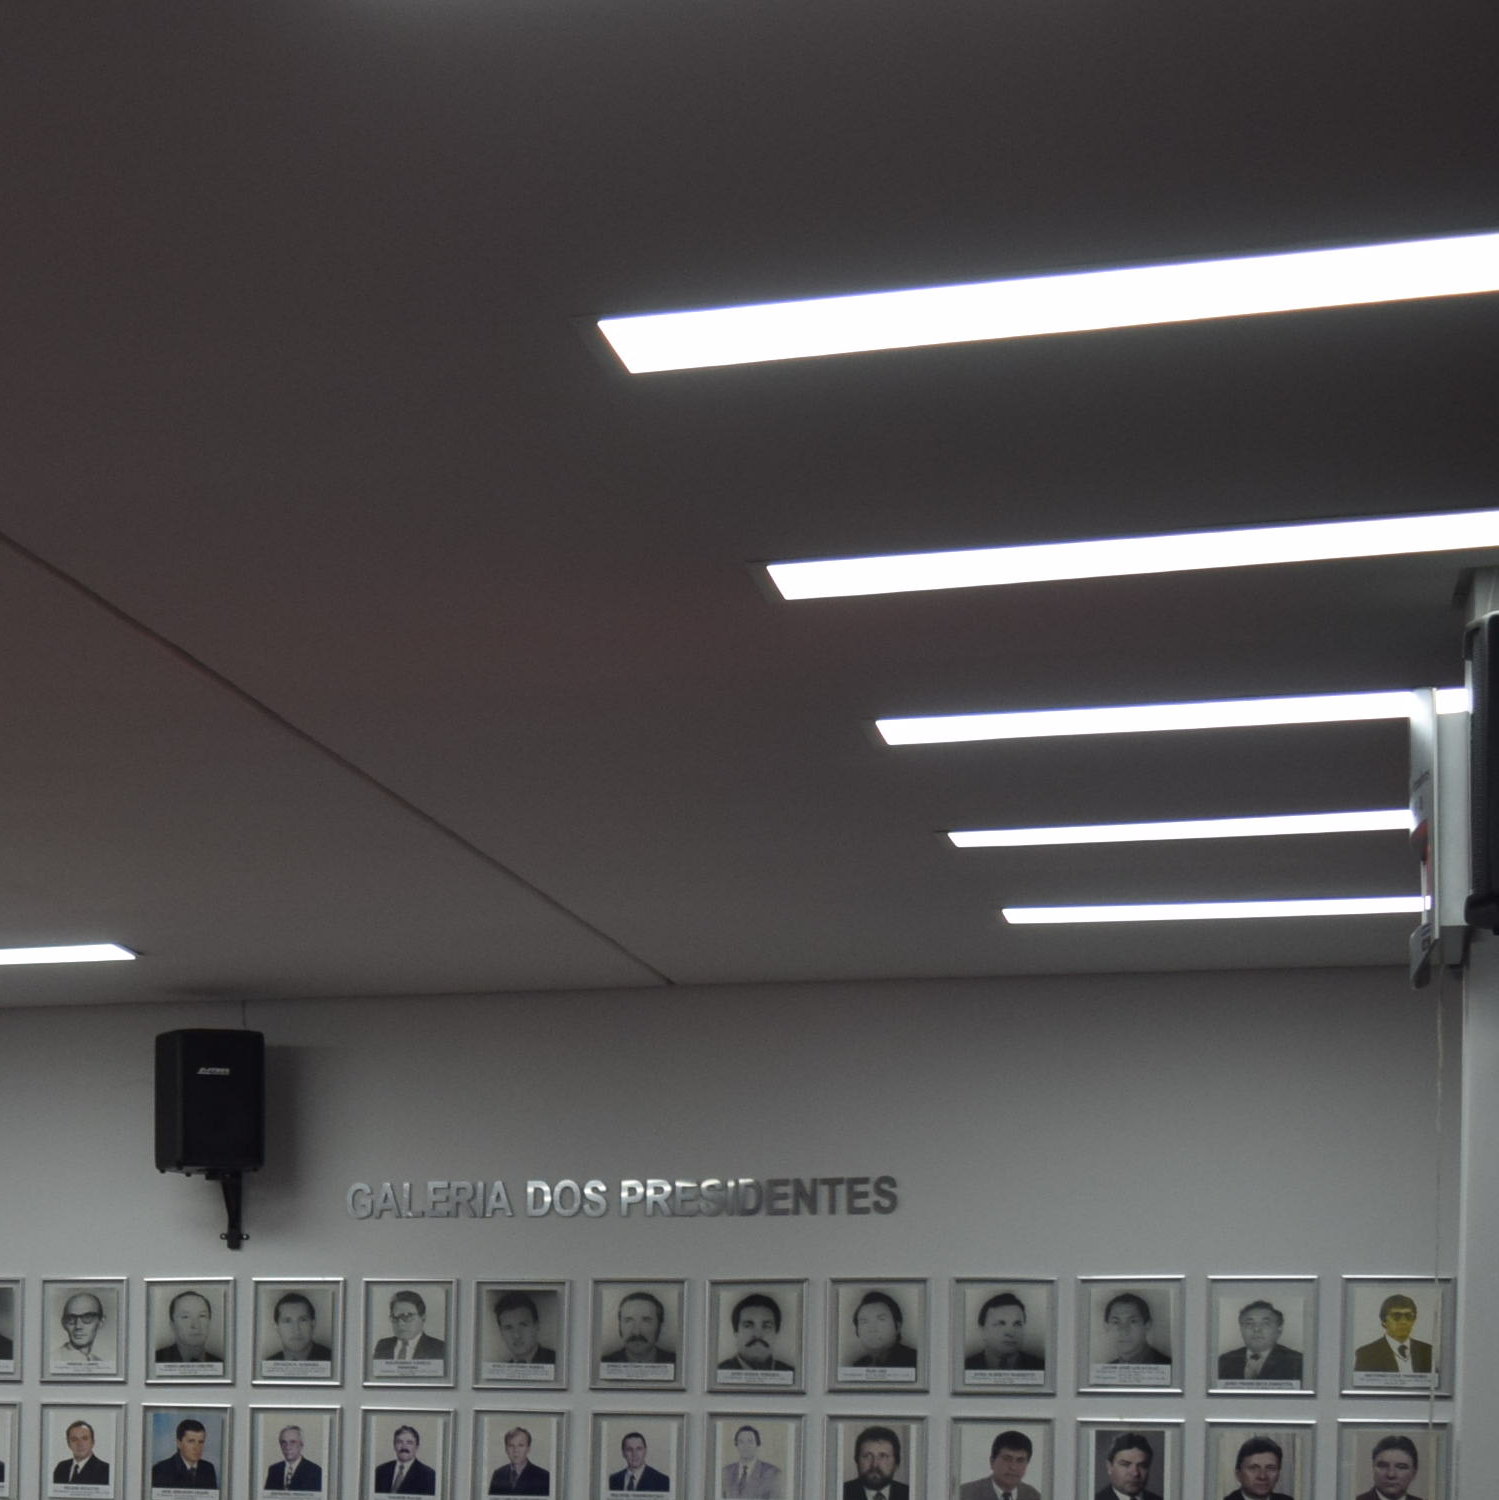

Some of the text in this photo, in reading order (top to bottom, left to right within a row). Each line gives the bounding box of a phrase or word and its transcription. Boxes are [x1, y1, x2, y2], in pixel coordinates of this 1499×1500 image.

[345, 1175, 899, 1219] GALERIA DOS PRESIDENTES
